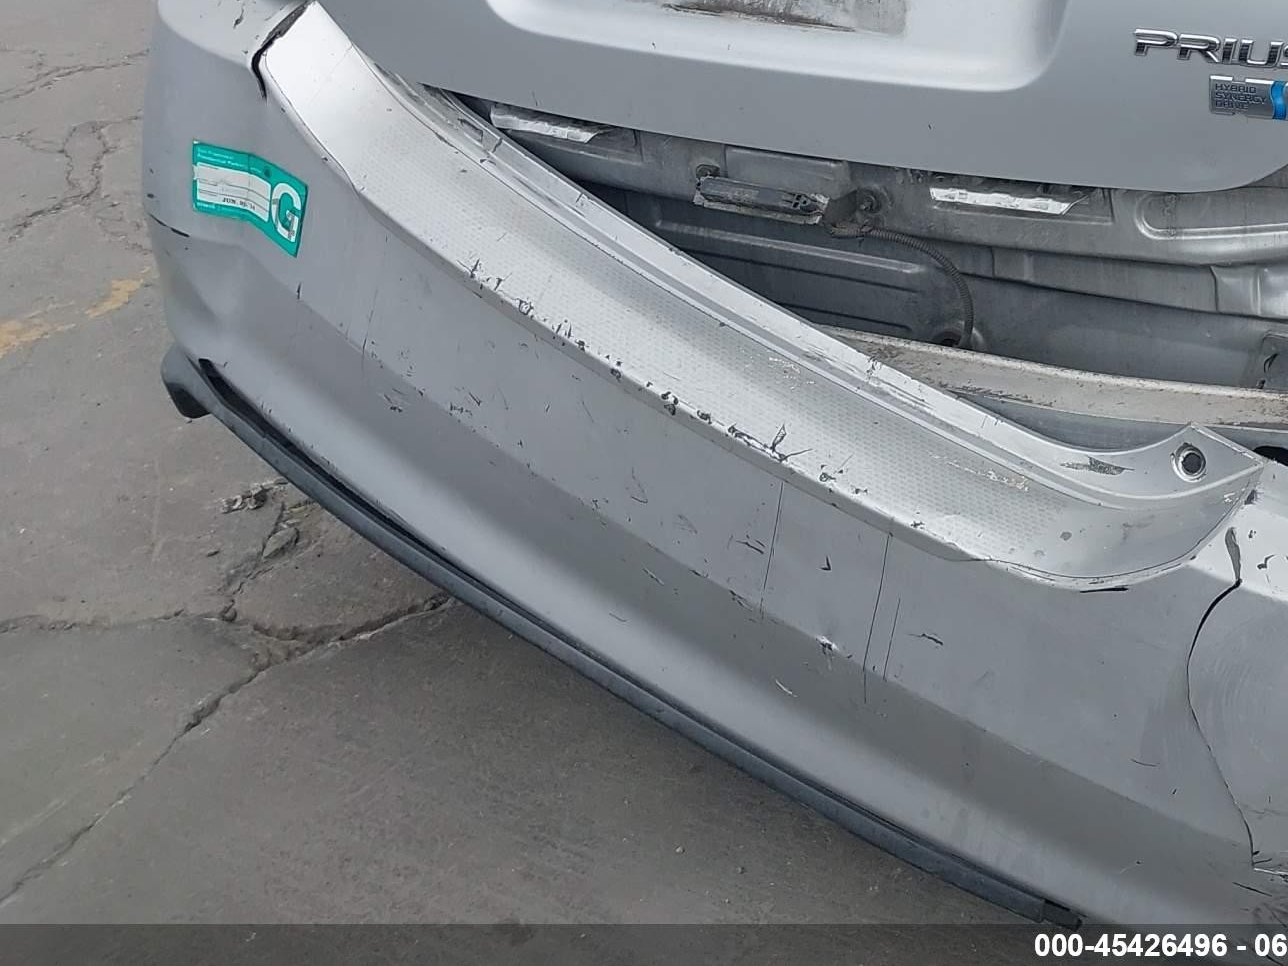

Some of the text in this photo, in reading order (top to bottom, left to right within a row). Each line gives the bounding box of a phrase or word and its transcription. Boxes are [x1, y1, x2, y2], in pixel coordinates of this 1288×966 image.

[1214, 83, 1257, 94] HYBRID
[1214, 92, 1268, 105] SYNERGY
[1214, 100, 1249, 111] DRIVE
[271, 182, 302, 243] G
